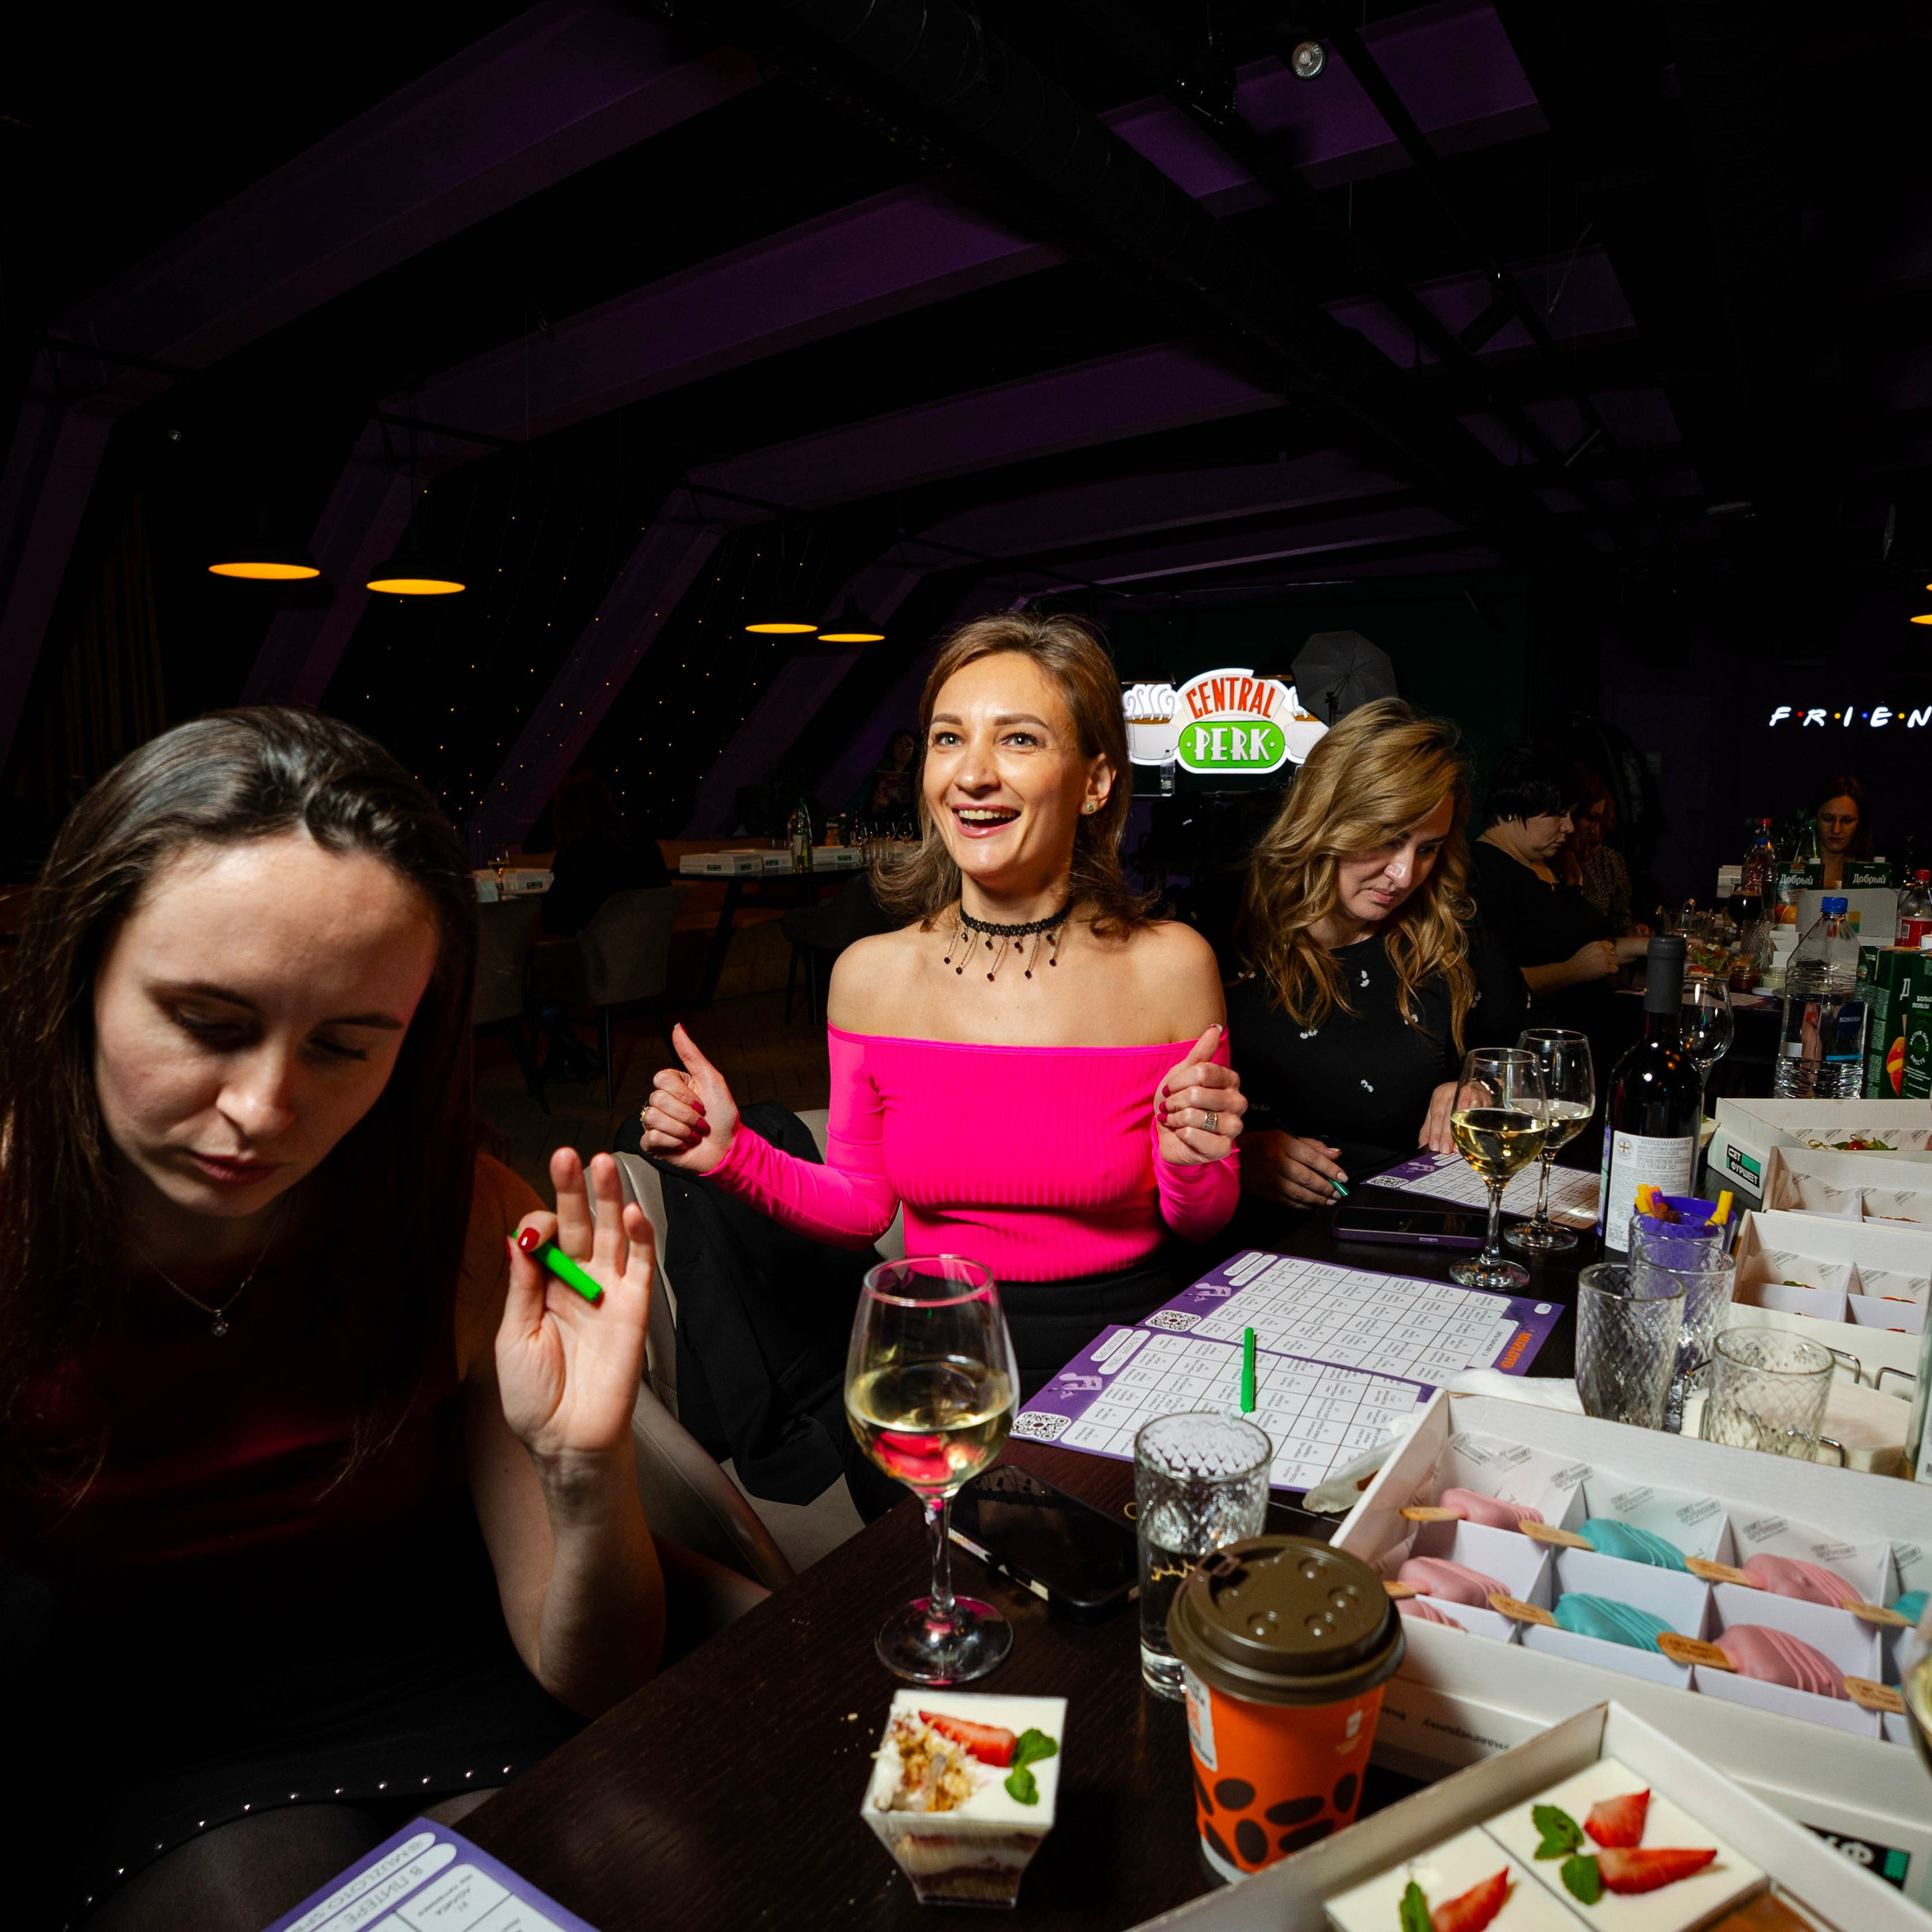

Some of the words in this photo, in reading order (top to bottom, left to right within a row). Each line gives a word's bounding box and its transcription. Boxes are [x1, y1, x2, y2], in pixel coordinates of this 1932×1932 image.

[1186, 677, 1276, 718] CENTRAL
[1195, 726, 1271, 761] PERK
[1780, 874, 1814, 886] Добрый
[1853, 874, 1886, 884] Добрый
[1728, 1147, 1741, 1161] СЕТ
[1730, 1161, 1758, 1185] ФУРШЕТ
[1500, 1331, 1532, 1369] MUZLOTO
[343, 1875, 410, 1924] ПИТЕРЕ
